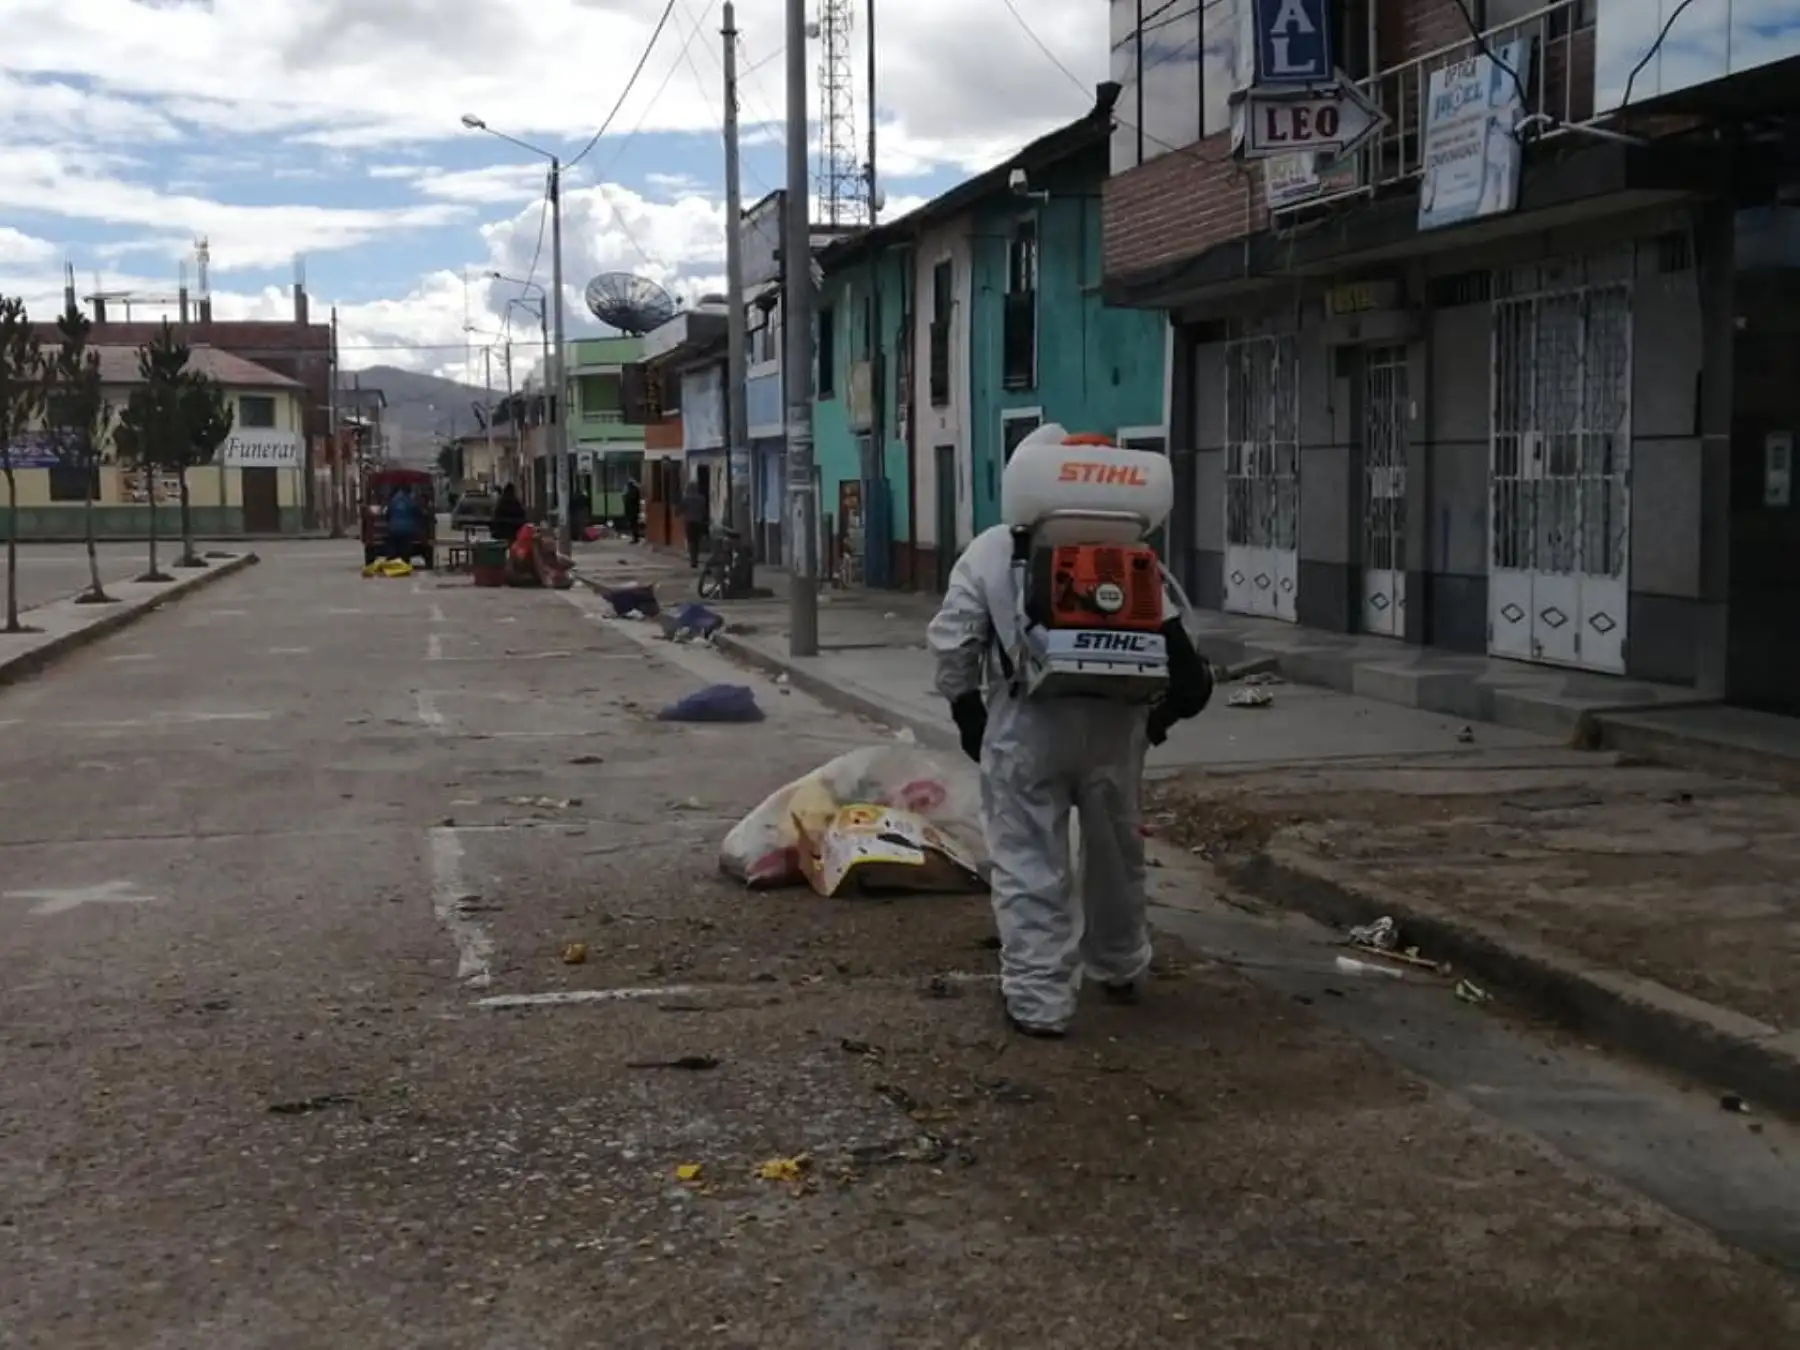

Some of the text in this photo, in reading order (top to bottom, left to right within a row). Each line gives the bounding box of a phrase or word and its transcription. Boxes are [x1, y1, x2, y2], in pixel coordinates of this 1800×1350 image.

[1266, 105, 1340, 141] LEO
[1058, 462, 1148, 487] STIHL
[1073, 632, 1146, 652] STIHL
